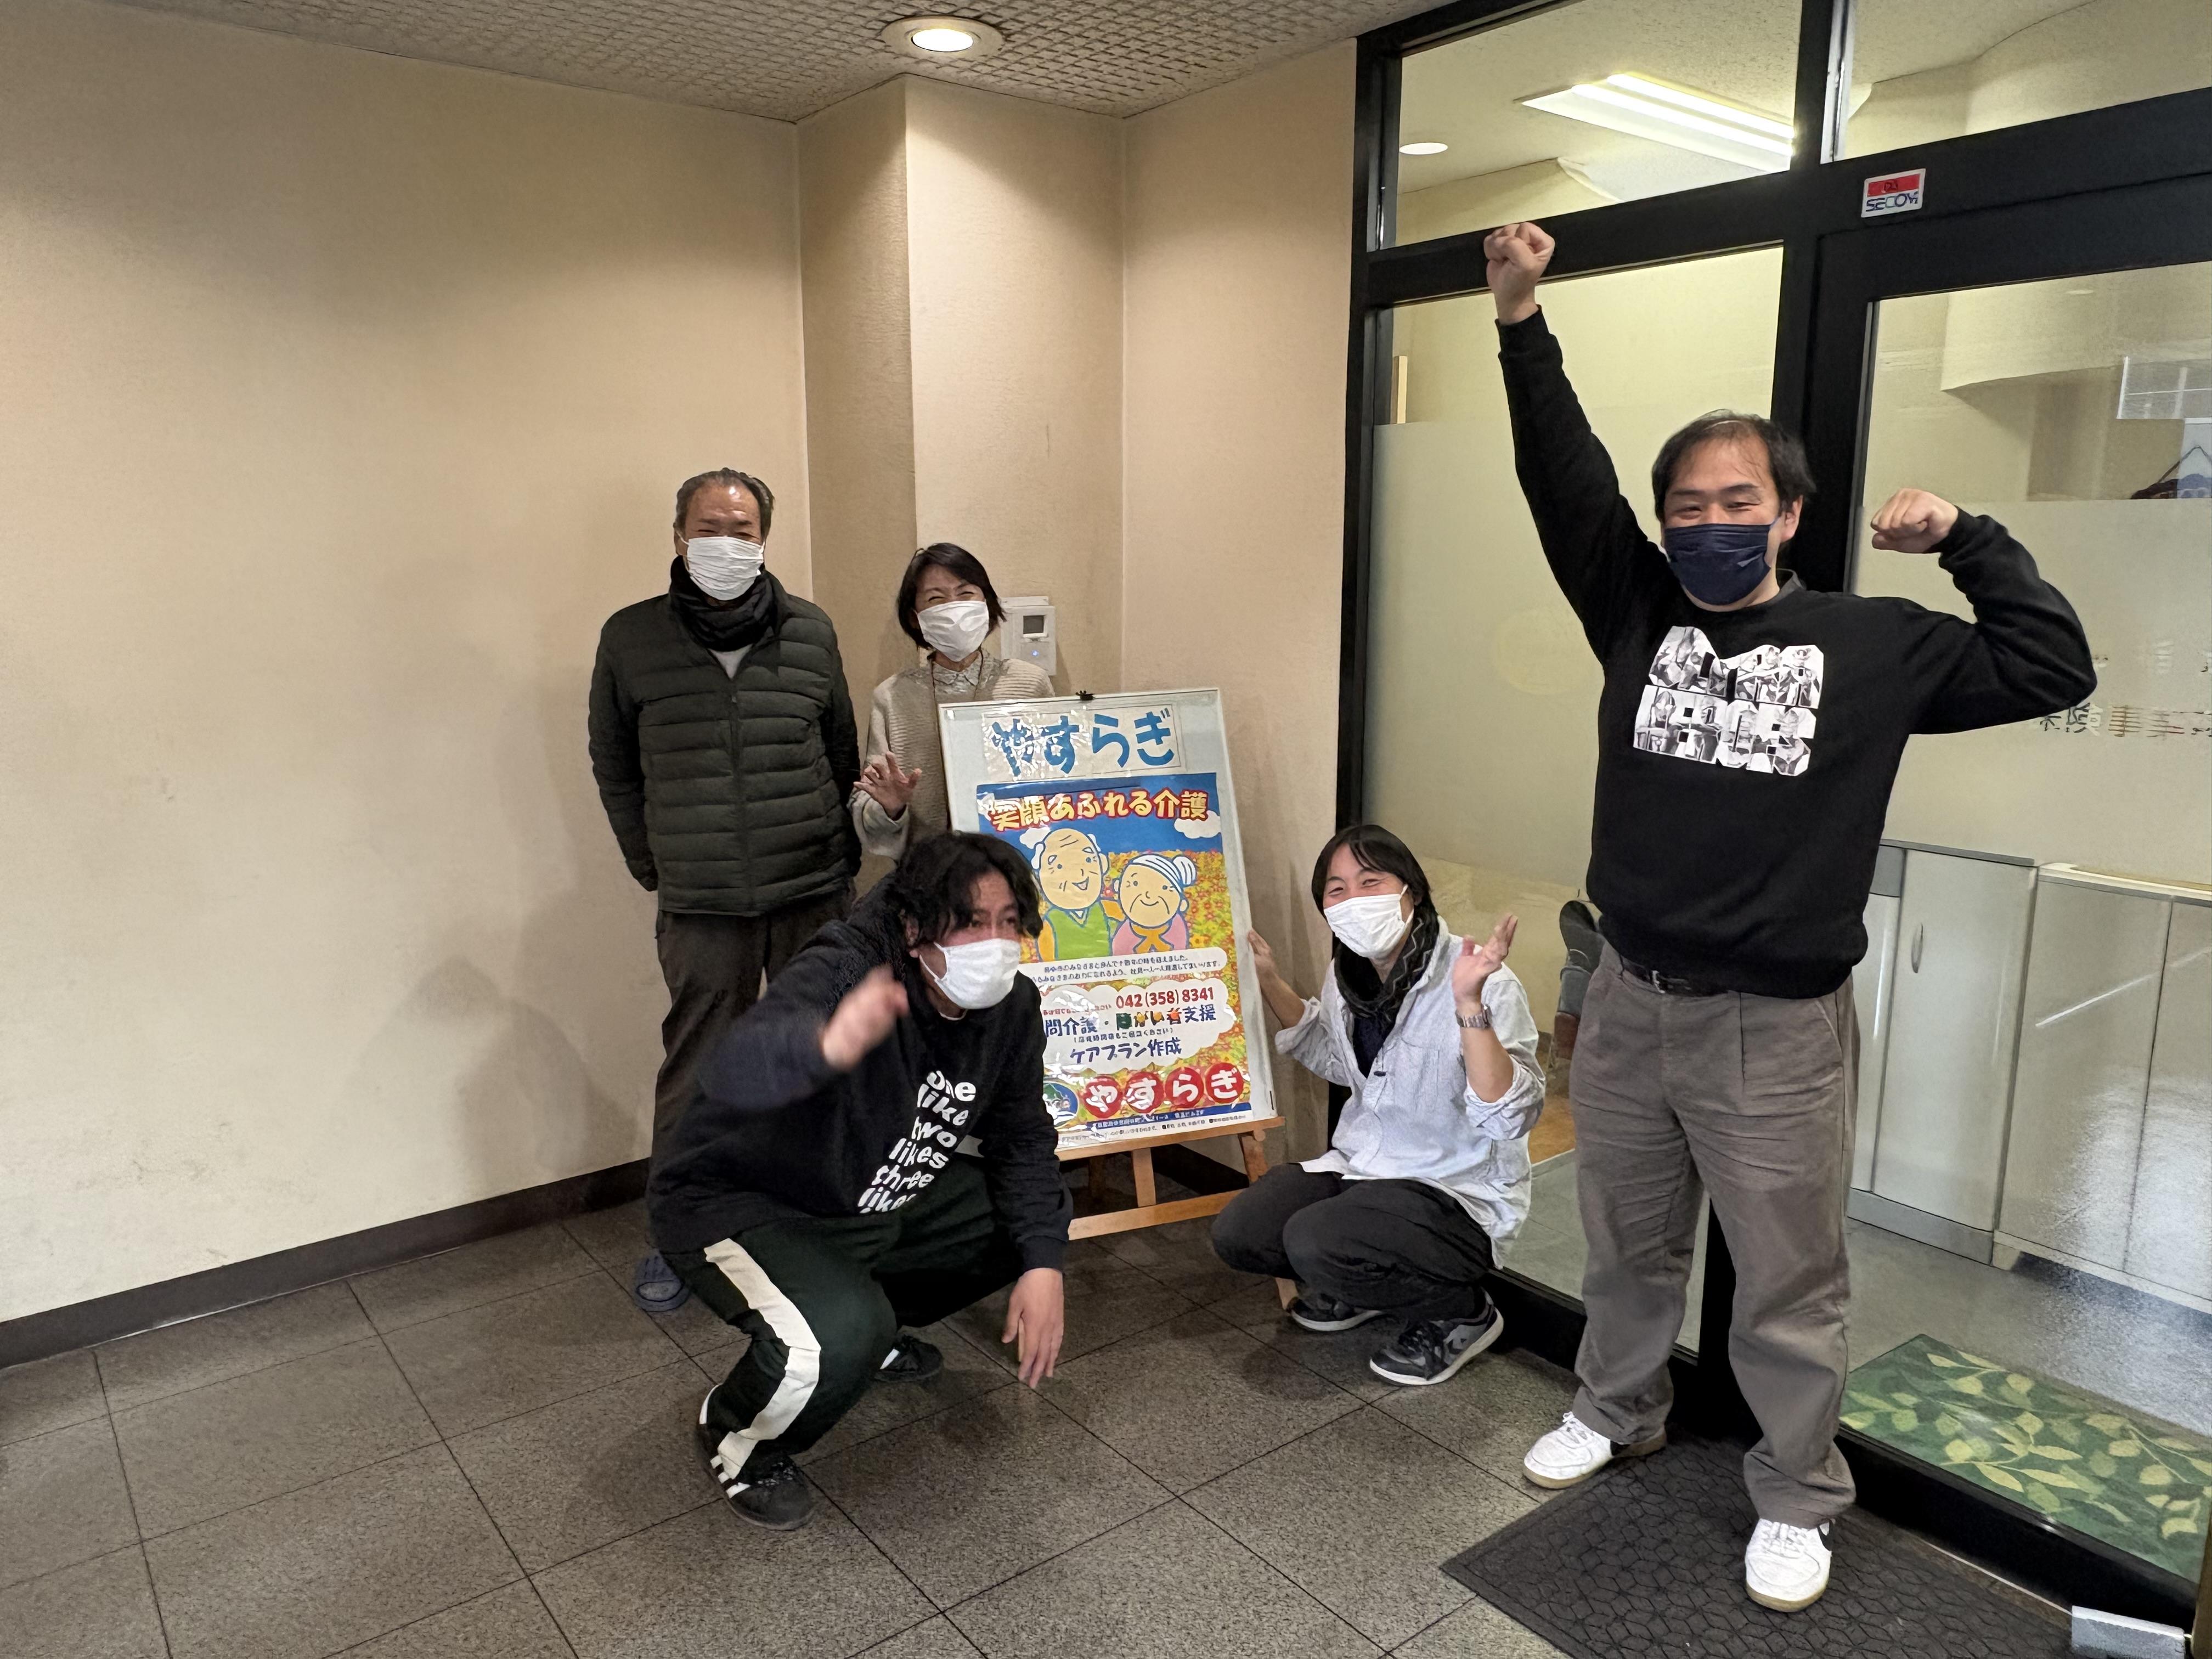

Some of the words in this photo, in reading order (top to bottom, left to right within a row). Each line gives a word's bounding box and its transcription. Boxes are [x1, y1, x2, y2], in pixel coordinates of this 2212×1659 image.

[991, 708, 1174, 777] やすらぎ
[989, 788, 1208, 832] 笑顔あふれる介護
[1115, 986, 1214, 1009] 042(358)8341
[1070, 1036, 1182, 1064] ケアプラン作成
[917, 1084, 969, 1126] like
[1086, 1066, 1238, 1113] やすらぎ
[889, 1138, 949, 1169] likes
